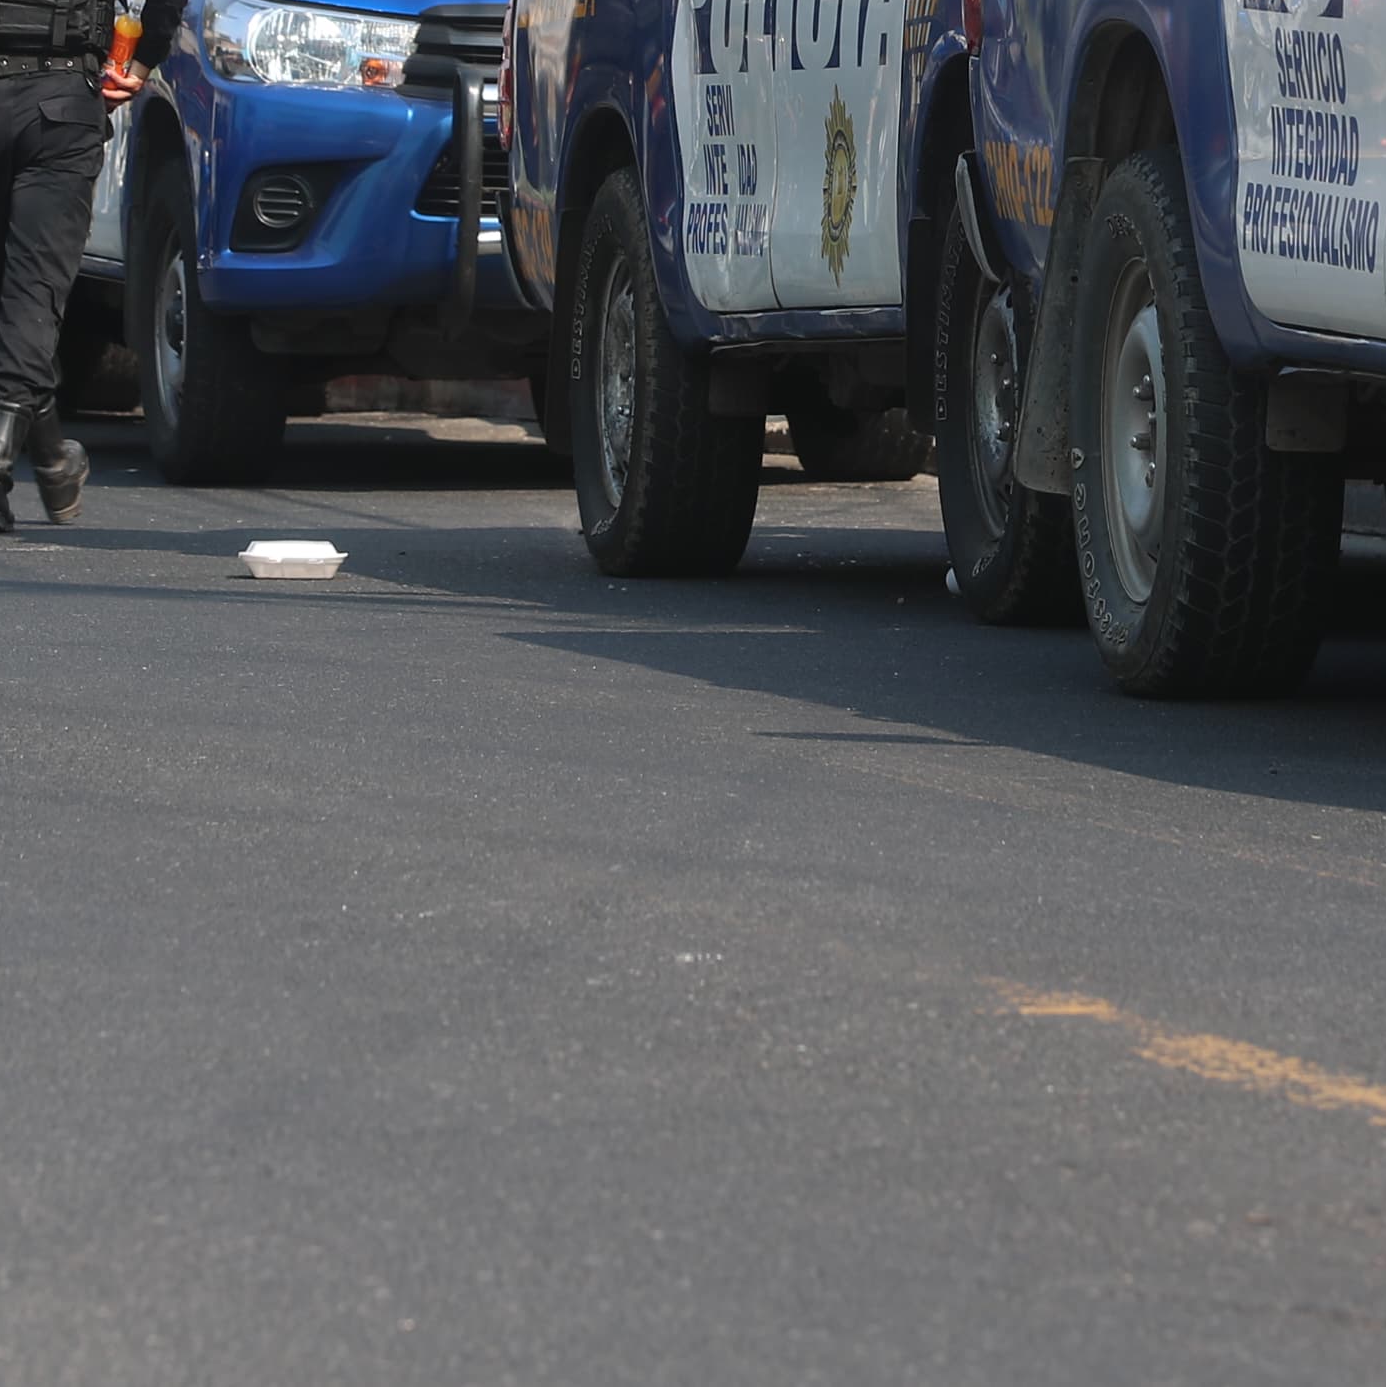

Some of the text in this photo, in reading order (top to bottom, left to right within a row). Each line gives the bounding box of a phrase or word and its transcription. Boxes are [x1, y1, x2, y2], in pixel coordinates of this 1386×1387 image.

[1274, 26, 1347, 105] SERVICIO
[705, 84, 736, 137] SERVI
[1270, 105, 1360, 187] INTEGRIDAD
[1242, 181, 1381, 274] PROFESIONALISMO
